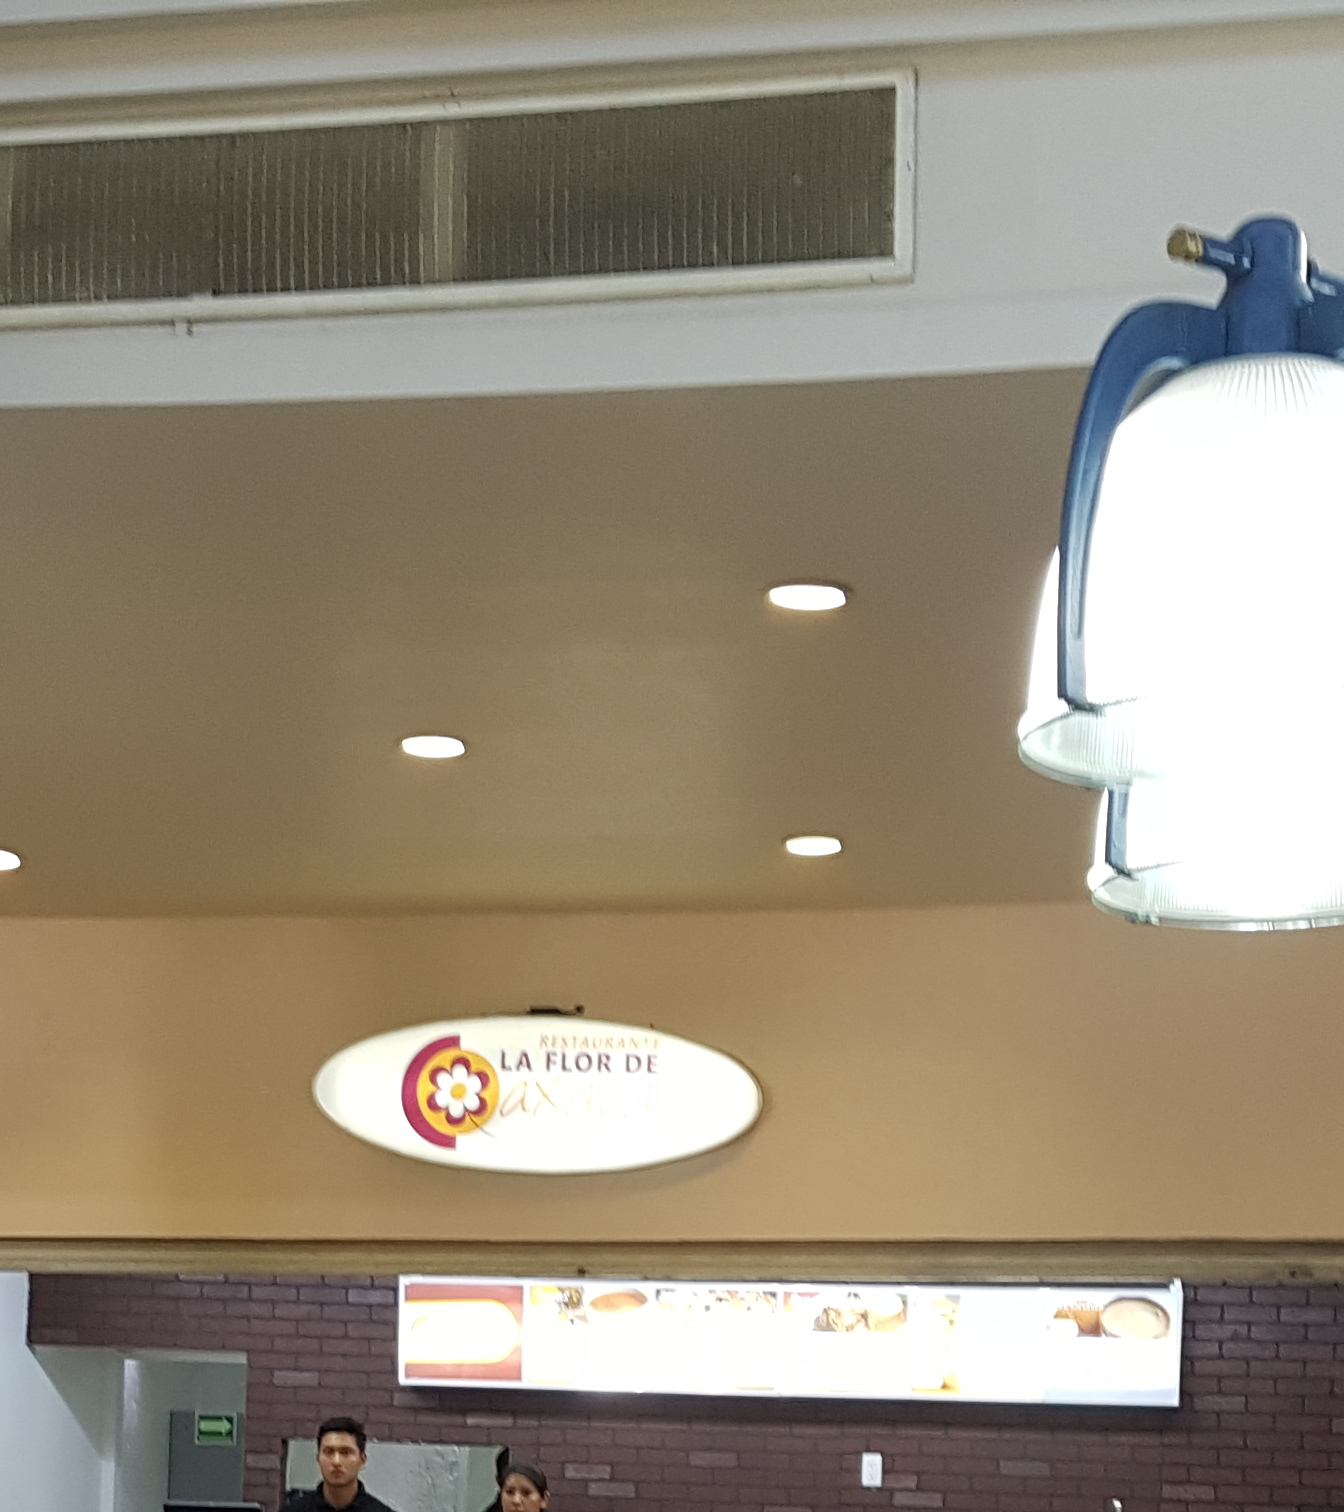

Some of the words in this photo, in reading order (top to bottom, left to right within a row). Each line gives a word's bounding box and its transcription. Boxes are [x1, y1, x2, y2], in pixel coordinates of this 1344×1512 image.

[501, 1050, 531, 1072] LA
[545, 1051, 613, 1074] FLOR
[625, 1053, 658, 1075] DE
